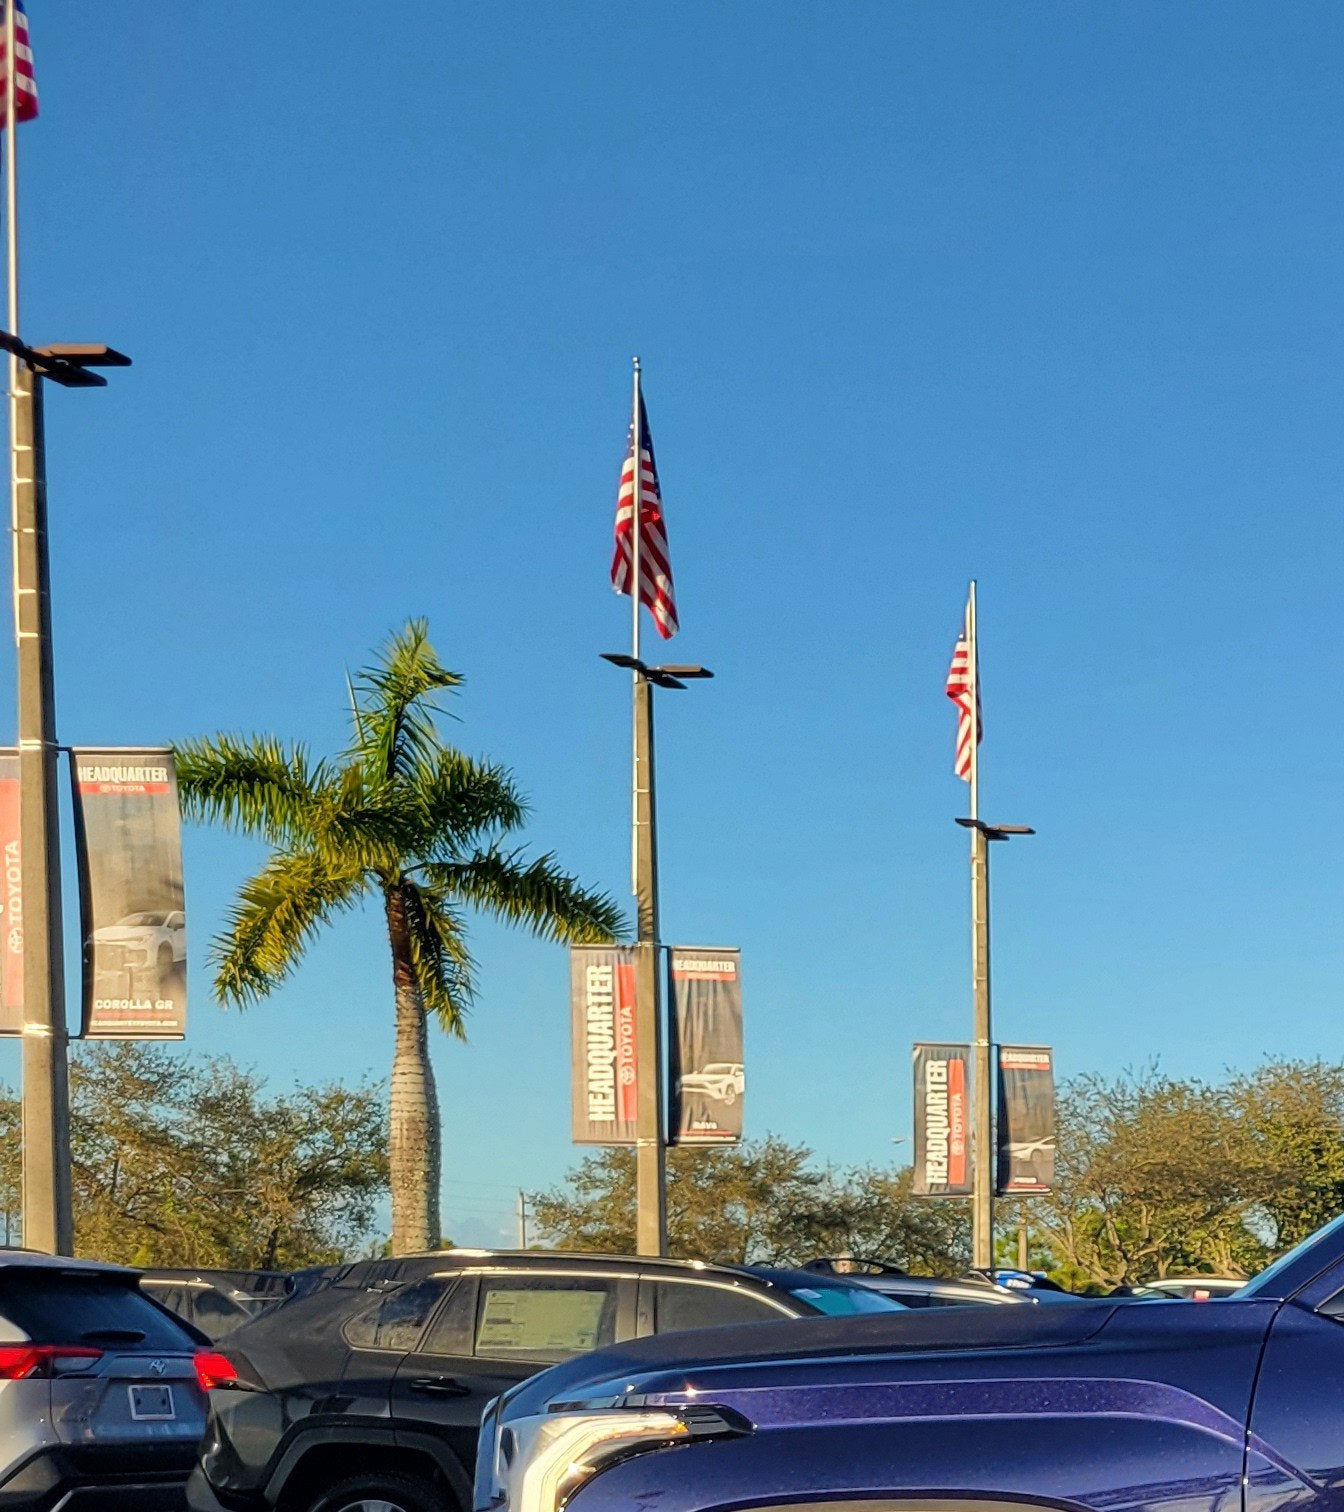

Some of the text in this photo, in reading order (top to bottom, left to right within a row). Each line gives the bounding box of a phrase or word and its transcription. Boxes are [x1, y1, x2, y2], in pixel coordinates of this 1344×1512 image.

[78, 766, 169, 783] HEADQUARTER
[111, 785, 146, 793] TOYOTA
[5, 840, 23, 925] TOYOTA
[94, 999, 174, 1010] COROLLA GR
[586, 965, 617, 1121] HEADQUARTER
[621, 1006, 634, 1067] TOYOTA
[926, 1059, 951, 1184] HEADQUARTER
